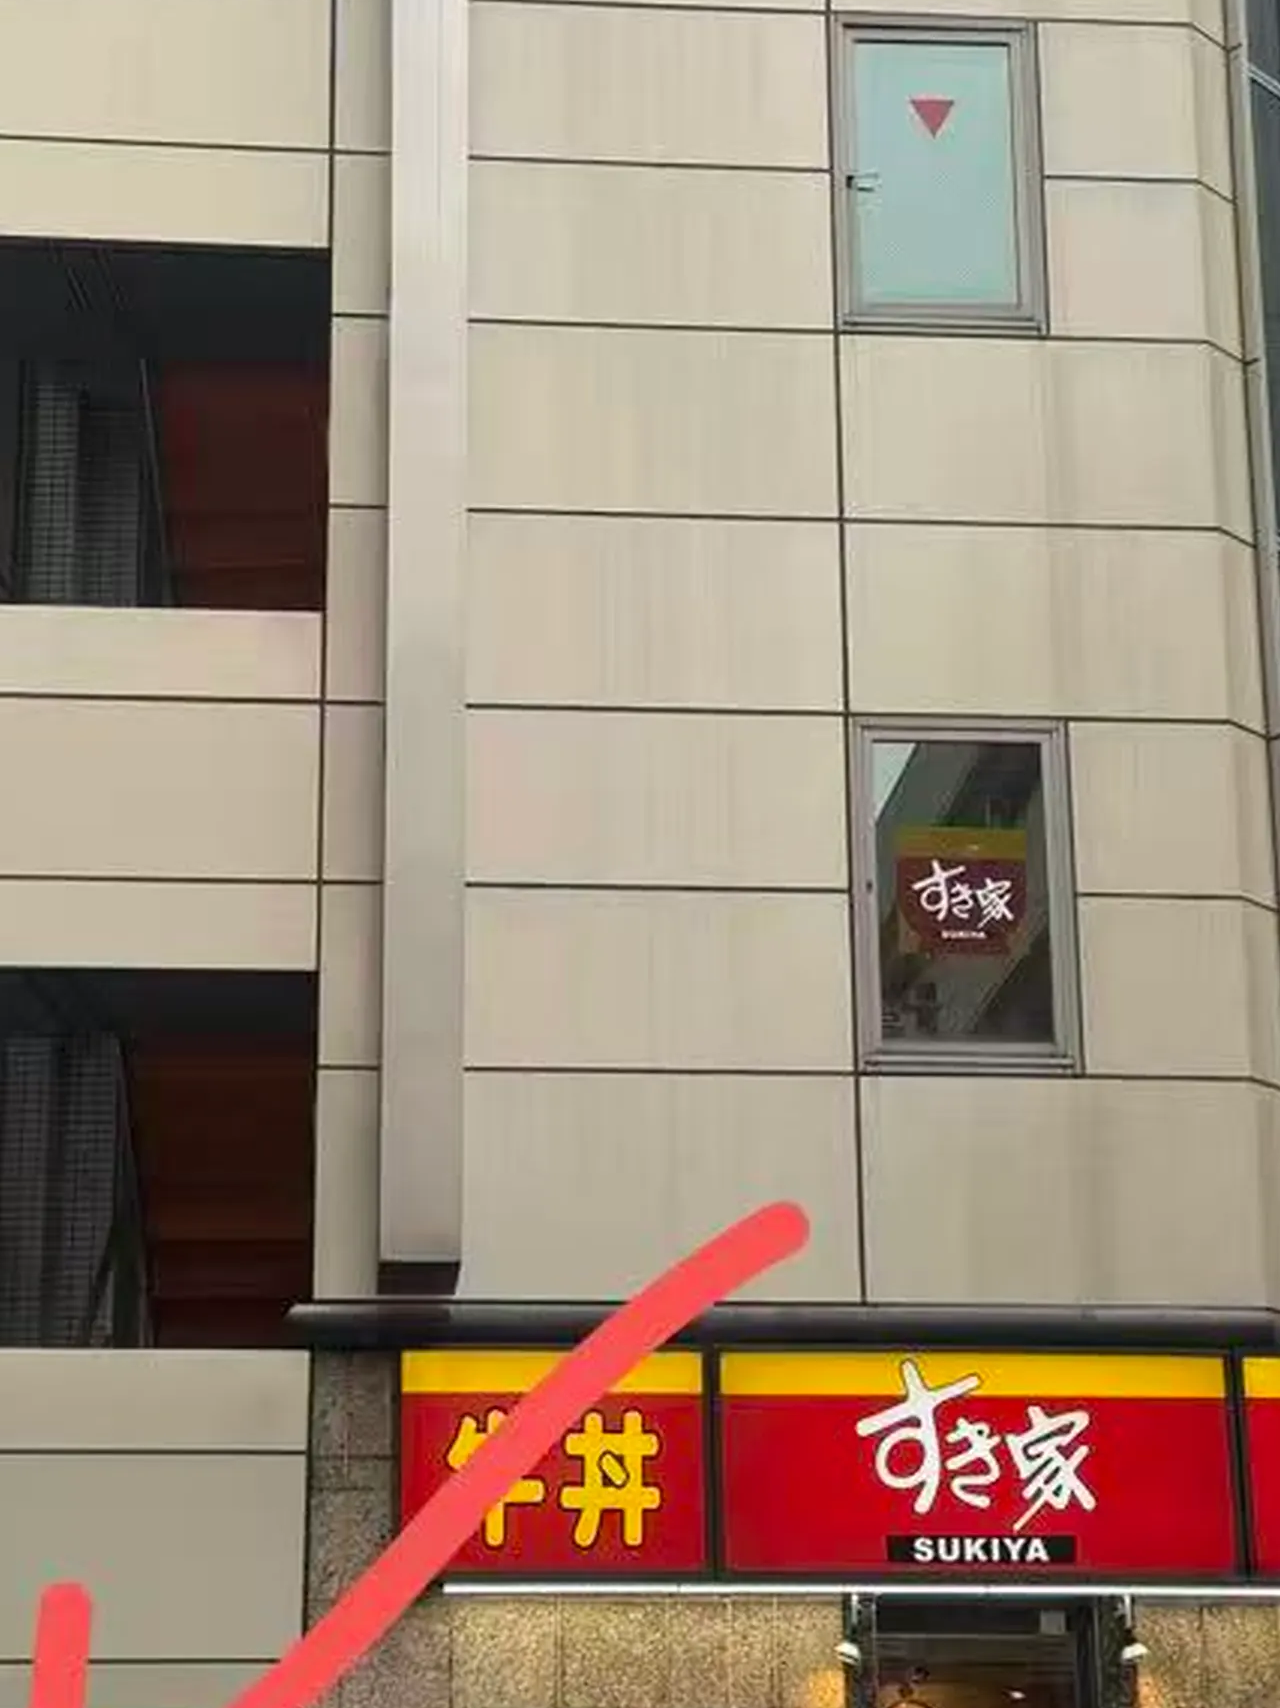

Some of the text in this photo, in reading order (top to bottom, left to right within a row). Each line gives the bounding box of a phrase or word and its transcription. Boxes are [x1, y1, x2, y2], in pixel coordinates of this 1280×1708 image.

[911, 858, 1015, 929] すき家
[856, 1359, 1097, 1531] すき家
[913, 1536, 1051, 1563] SUKIYA
